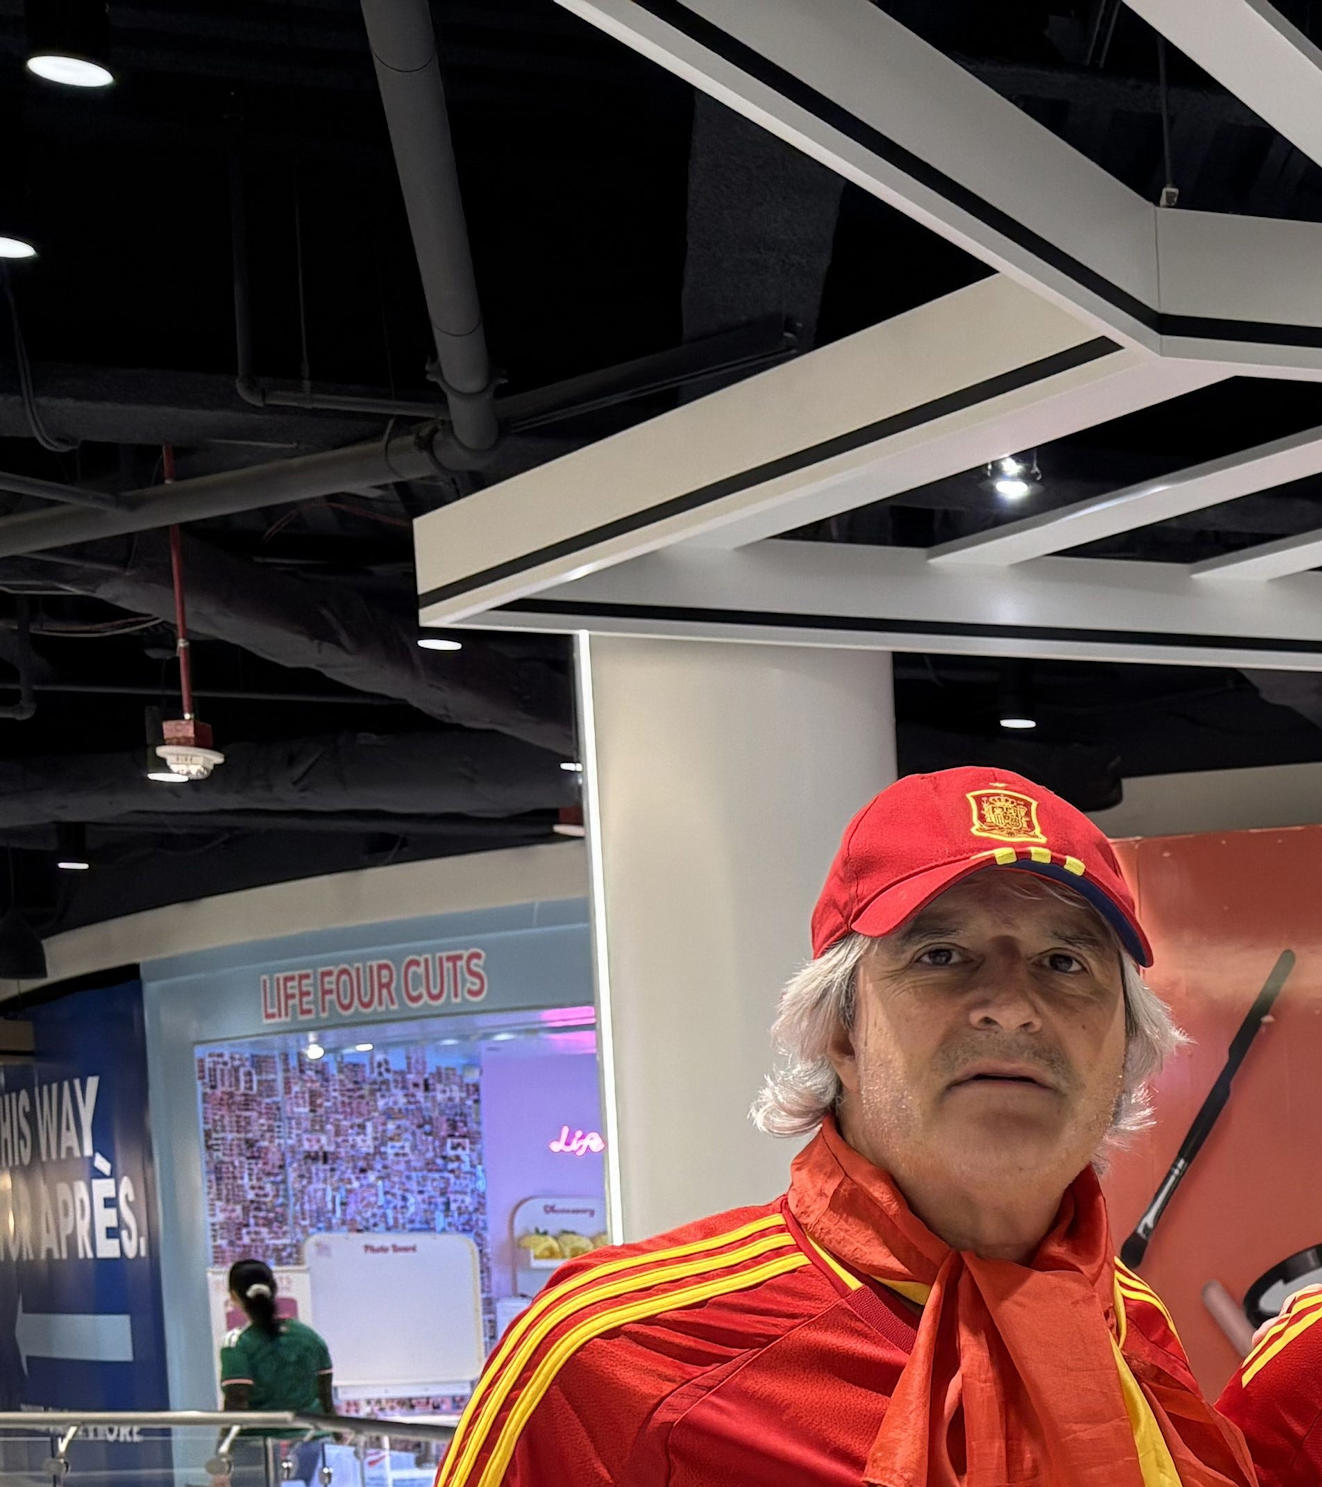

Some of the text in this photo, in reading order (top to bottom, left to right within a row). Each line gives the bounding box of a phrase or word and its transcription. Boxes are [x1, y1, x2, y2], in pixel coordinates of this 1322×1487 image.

[262, 950, 486, 1021] LIFE FOUR CUTS
[0, 1076, 99, 1167] HIS WAY
[0, 1152, 146, 1261] OR APRÈS.
